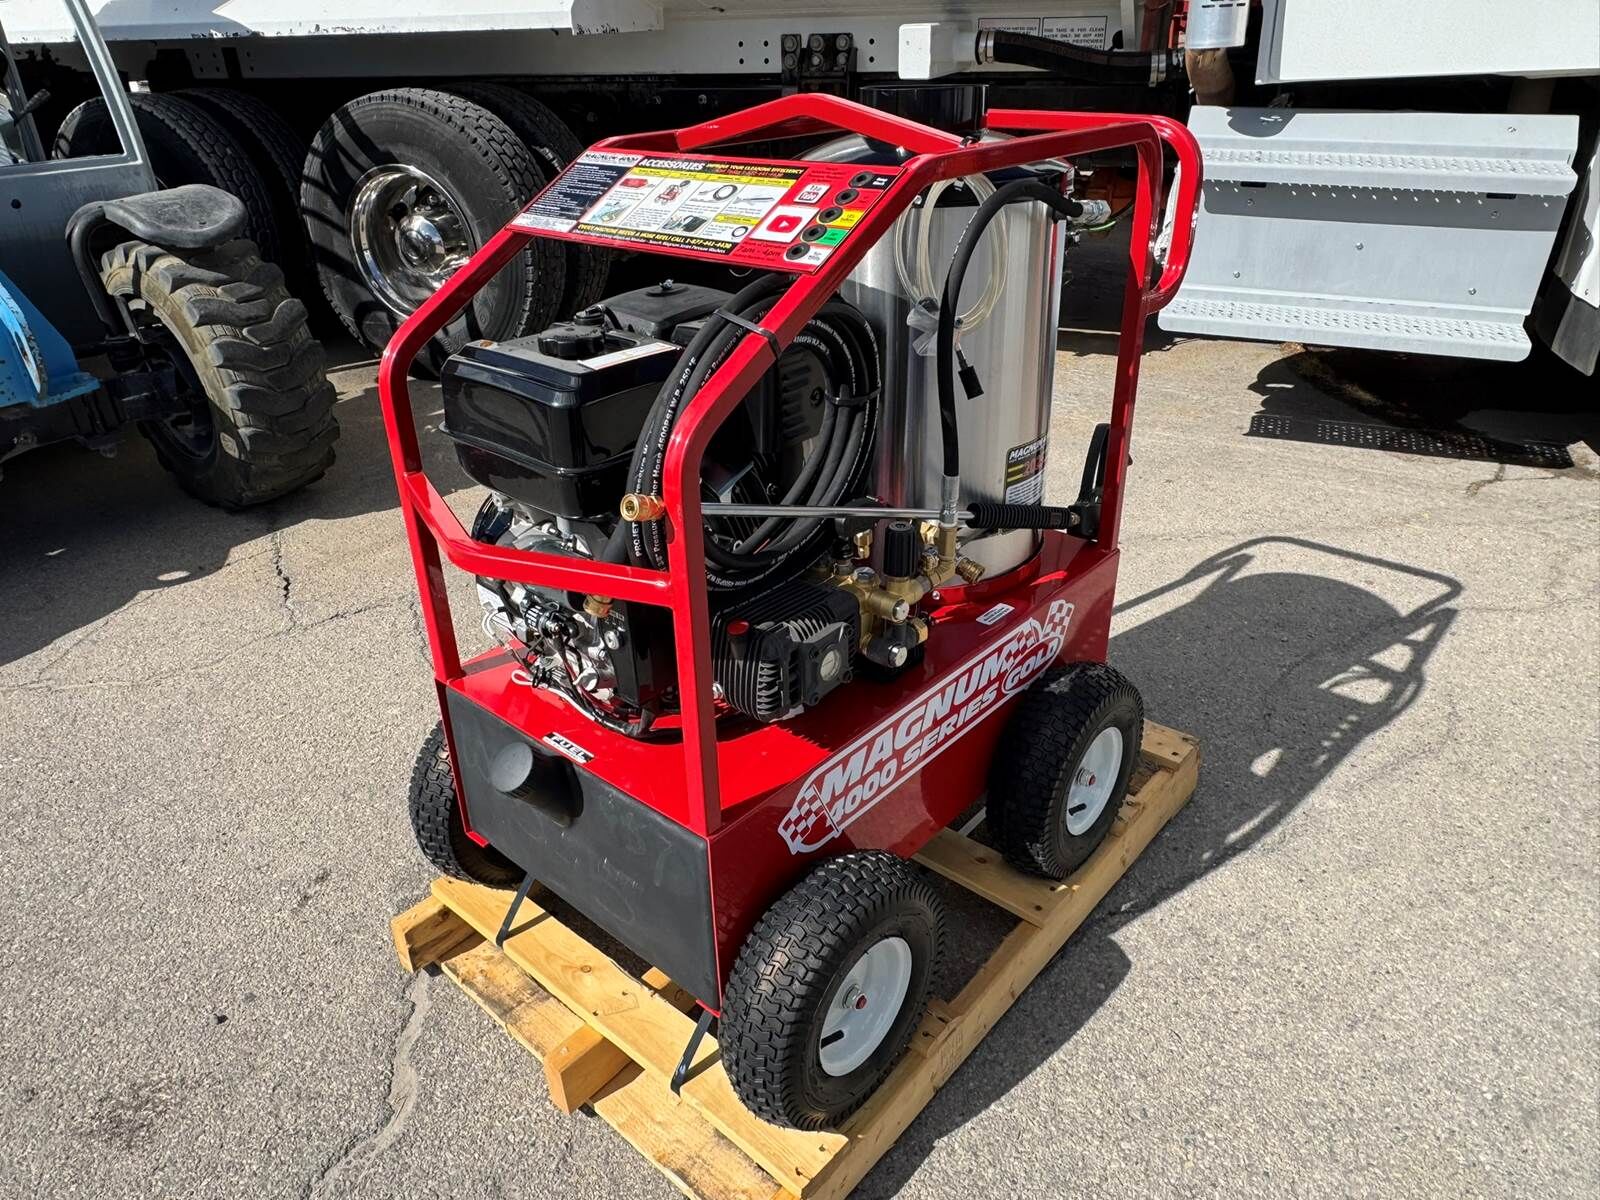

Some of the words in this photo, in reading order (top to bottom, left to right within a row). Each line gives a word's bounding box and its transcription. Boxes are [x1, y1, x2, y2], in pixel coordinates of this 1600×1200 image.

[639, 159, 706, 170] ACCESSORIES
[763, 248, 781, 256] 4pm
[679, 367, 691, 386] 250
[1005, 637, 1060, 691] GOLD
[820, 642, 1019, 802] MAGNUM
[826, 758, 898, 827] 4000
[901, 682, 999, 771] SERIES
